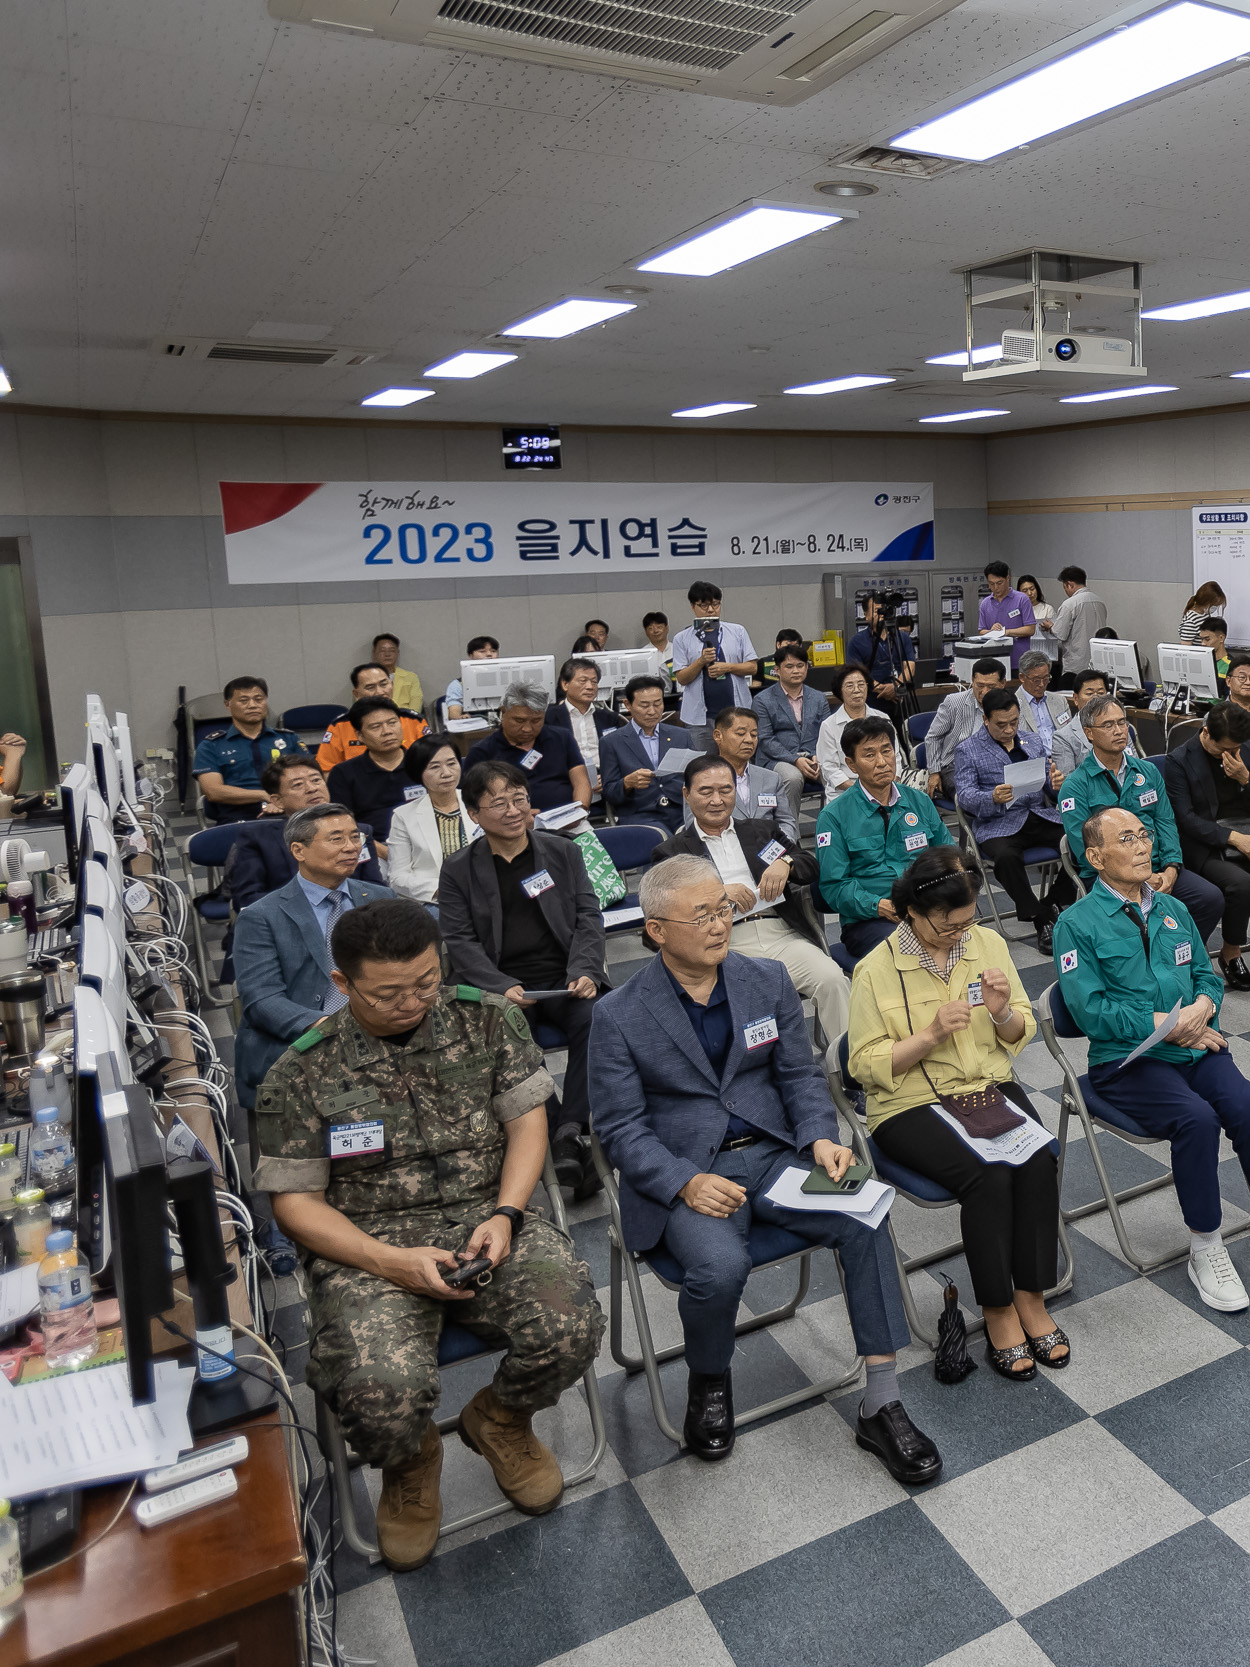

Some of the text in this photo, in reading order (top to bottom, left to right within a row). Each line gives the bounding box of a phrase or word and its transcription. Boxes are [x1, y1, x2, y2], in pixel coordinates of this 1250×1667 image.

[892, 495, 921, 504] 광진구
[362, 517, 708, 566] 2023 을지연습
[730, 536, 746, 556] 8.
[826, 533, 869, 553] 24.(목)
[750, 1029, 774, 1044] 장형순
[342, 1136, 374, 1149] 허 준
